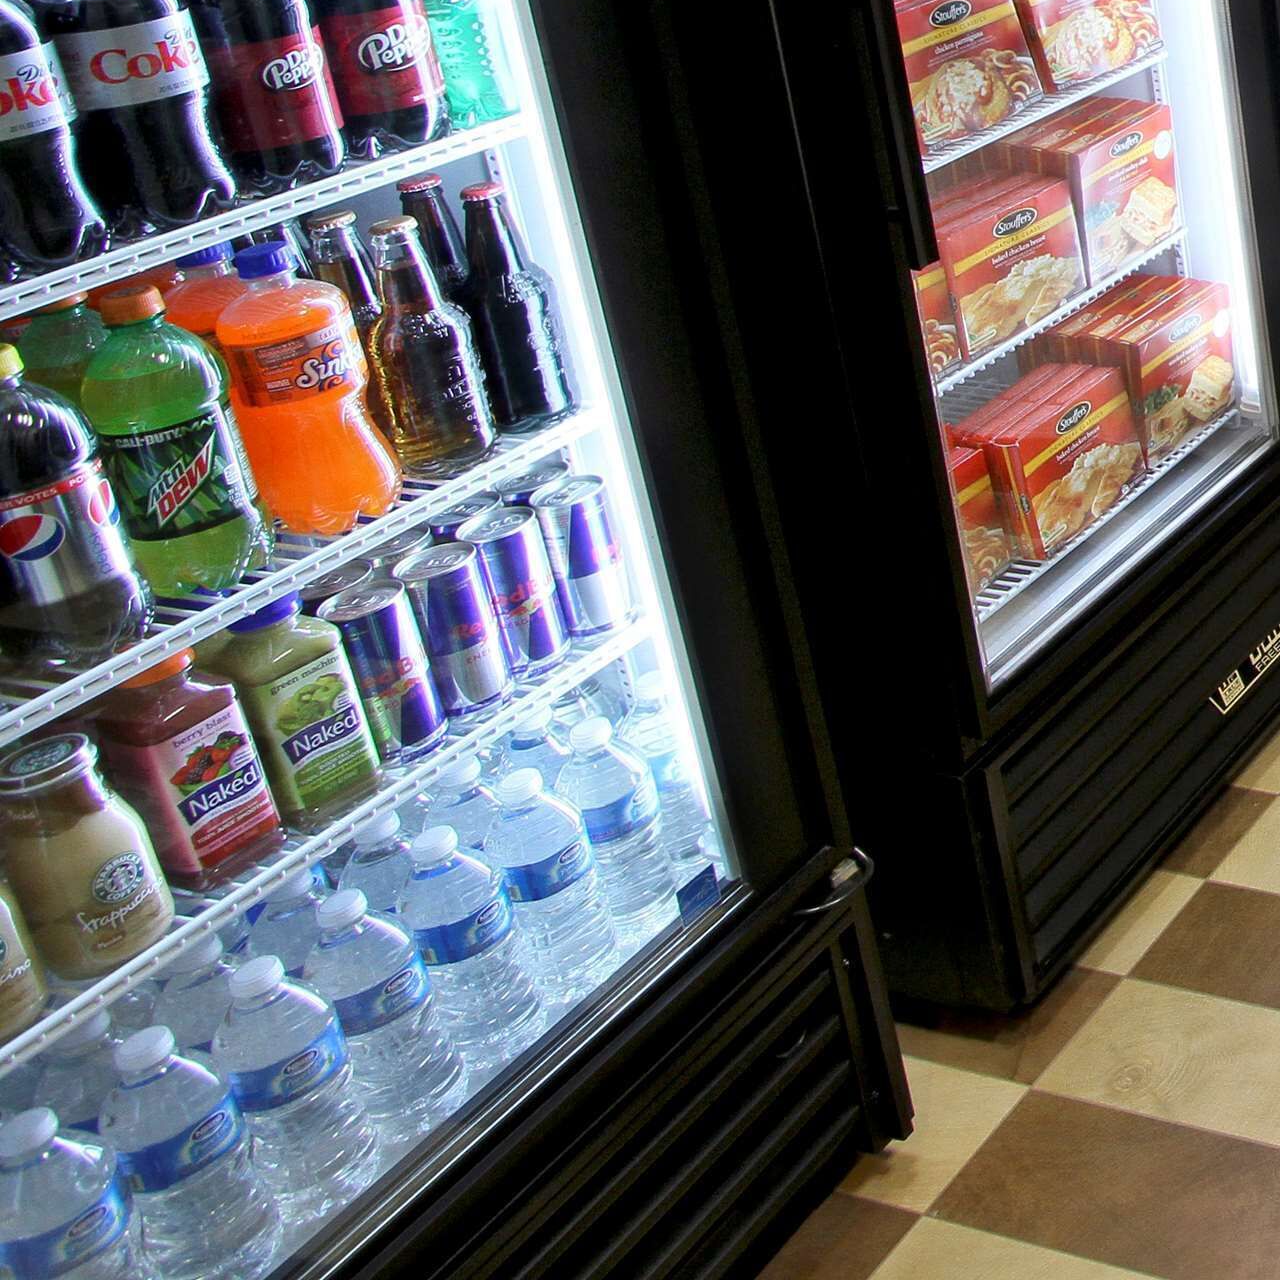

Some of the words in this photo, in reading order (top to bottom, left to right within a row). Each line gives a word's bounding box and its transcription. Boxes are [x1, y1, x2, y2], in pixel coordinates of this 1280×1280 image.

[934, 0, 968, 24] Stouffer's
[997, 211, 1036, 234] Stouffer's
[1058, 402, 1089, 432] Stouffer's
[15, 486, 58, 505] VOTES
[270, 674, 299, 696] green
[173, 728, 204, 749] berry
[206, 710, 234, 731] blast
[293, 704, 360, 757] Naked
[188, 765, 260, 818] Naked
